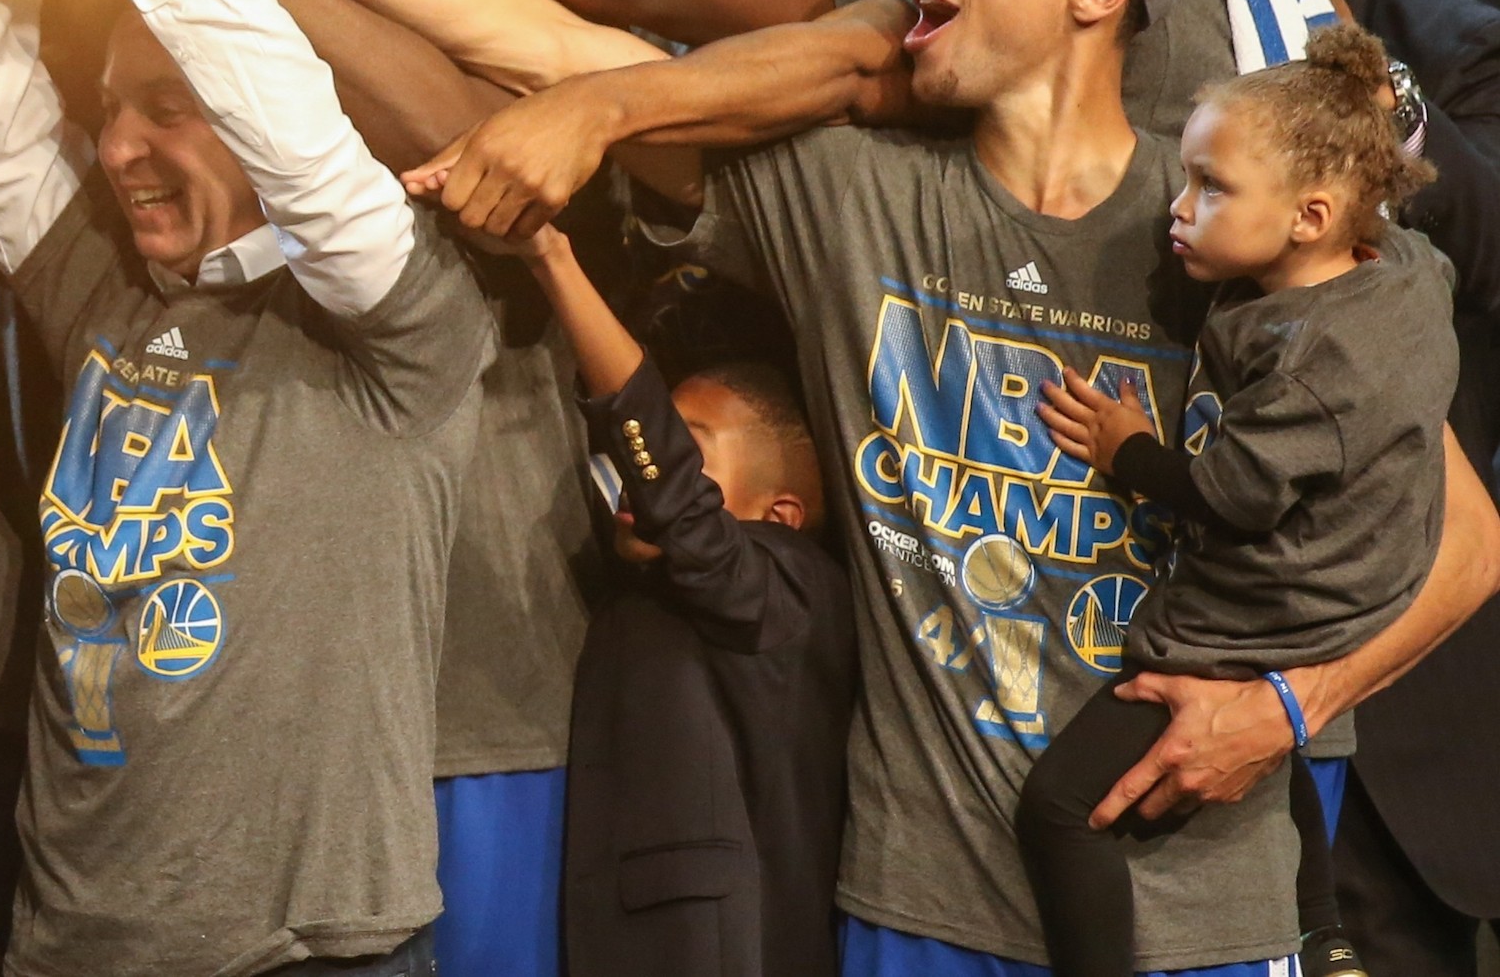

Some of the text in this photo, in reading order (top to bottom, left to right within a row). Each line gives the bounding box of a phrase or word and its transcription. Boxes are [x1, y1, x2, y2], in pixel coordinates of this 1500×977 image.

[1005, 277, 1049, 296] adidas
[922, 272, 1151, 341] GOEN STATE WARRIORS
[145, 343, 189, 361] adidas
[40, 495, 235, 584] AMPS
[868, 520, 920, 553] OCKER
